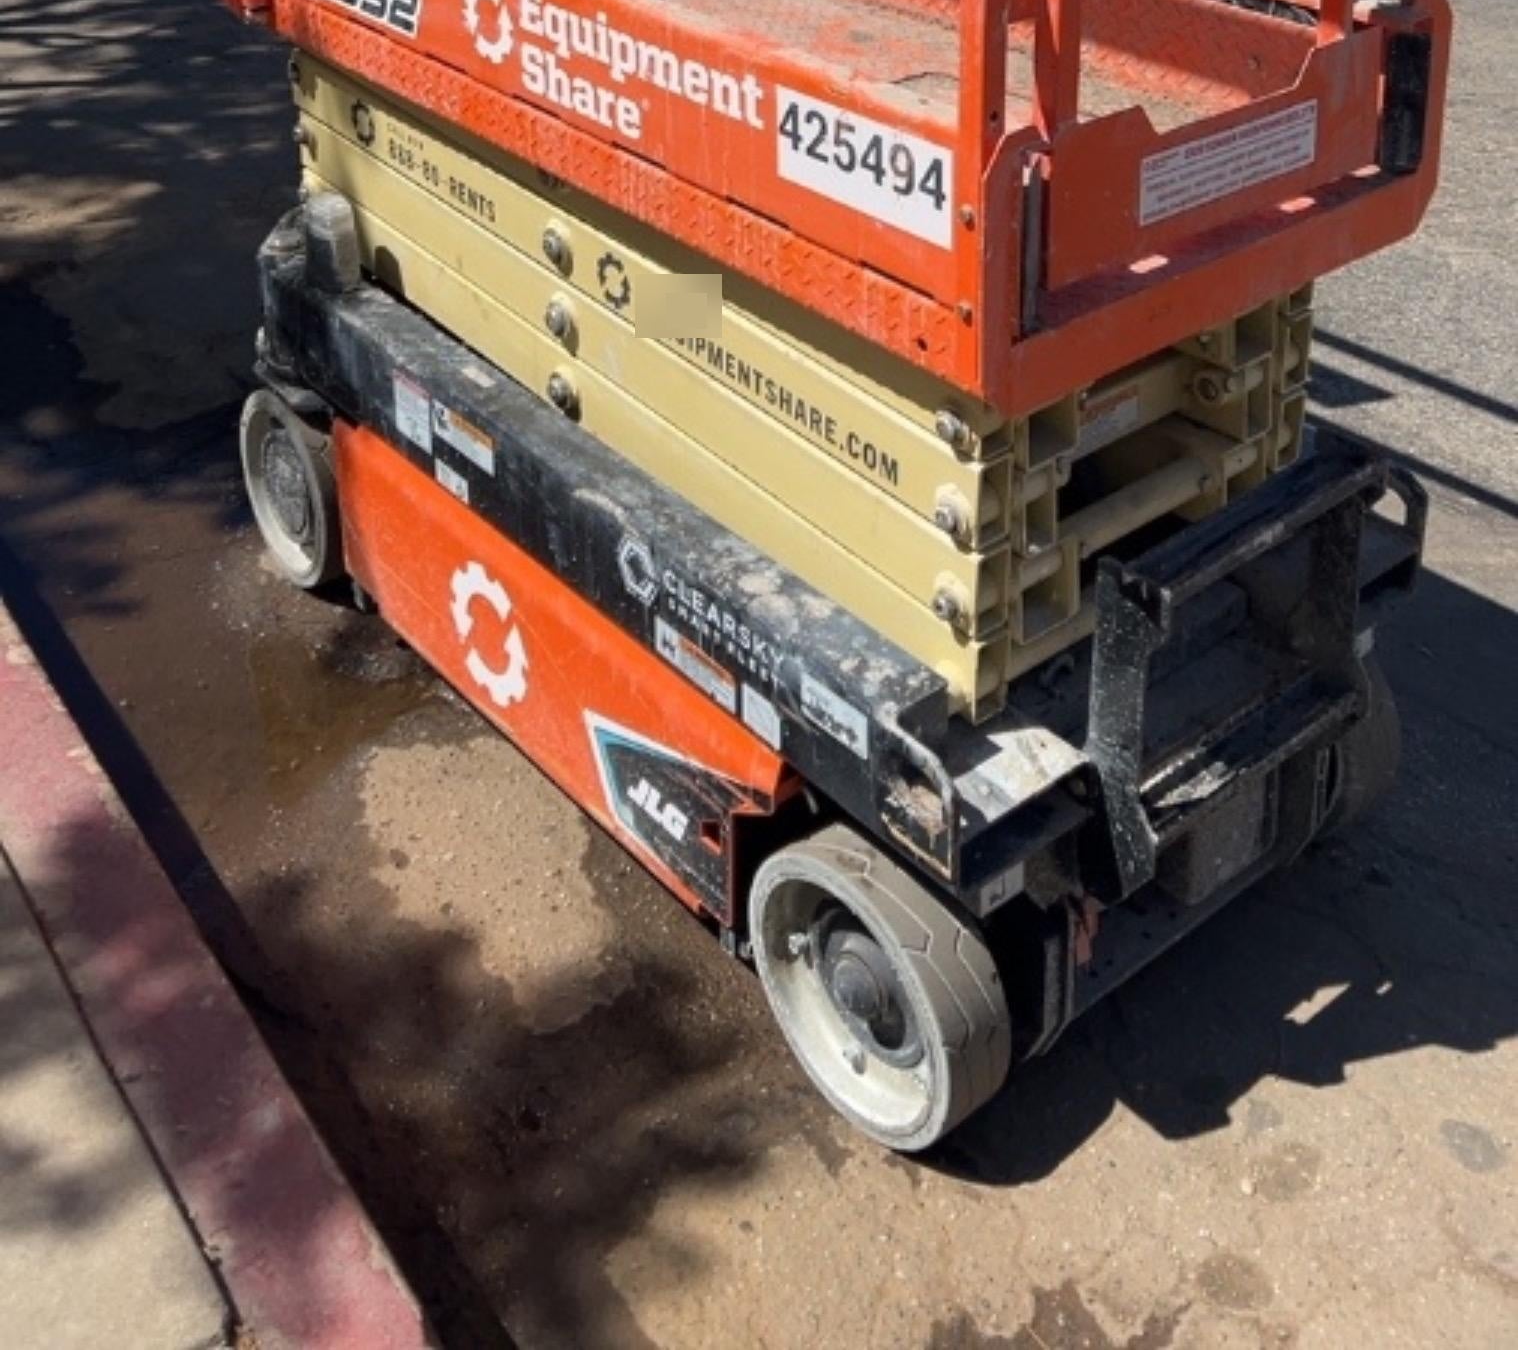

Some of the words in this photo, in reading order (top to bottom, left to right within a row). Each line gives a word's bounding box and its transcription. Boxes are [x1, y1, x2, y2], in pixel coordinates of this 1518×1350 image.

[519, 42, 642, 139] Share
[778, 100, 947, 211] 425494
[626, 778, 689, 842] JLG
